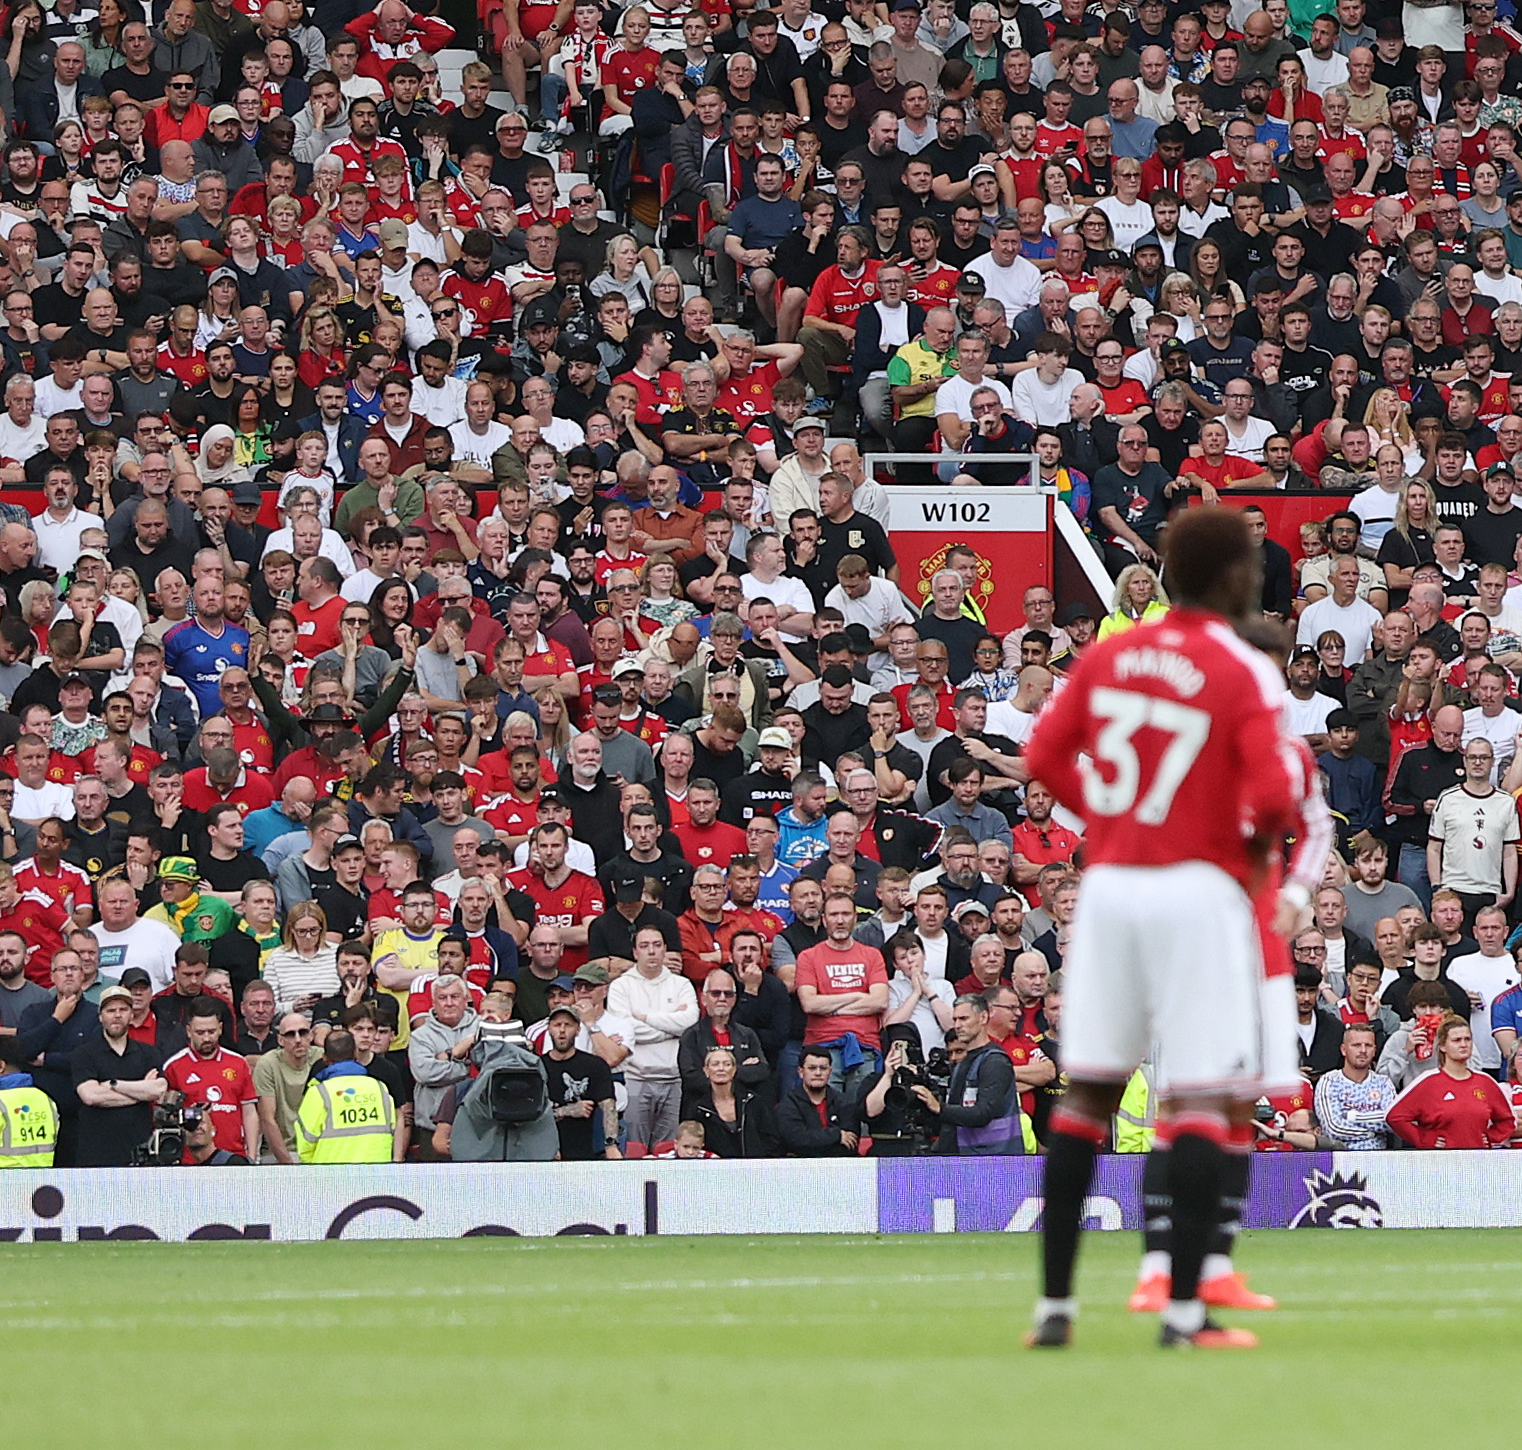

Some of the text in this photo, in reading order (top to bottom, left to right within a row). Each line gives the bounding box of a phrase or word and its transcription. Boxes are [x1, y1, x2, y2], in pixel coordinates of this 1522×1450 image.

[922, 502, 991, 523] W102
[1080, 687, 1212, 826] 37
[751, 790, 792, 800] SHAR
[826, 964, 865, 976] VENICE
[339, 1108, 379, 1125] 1034
[20, 1125, 46, 1142] 914
